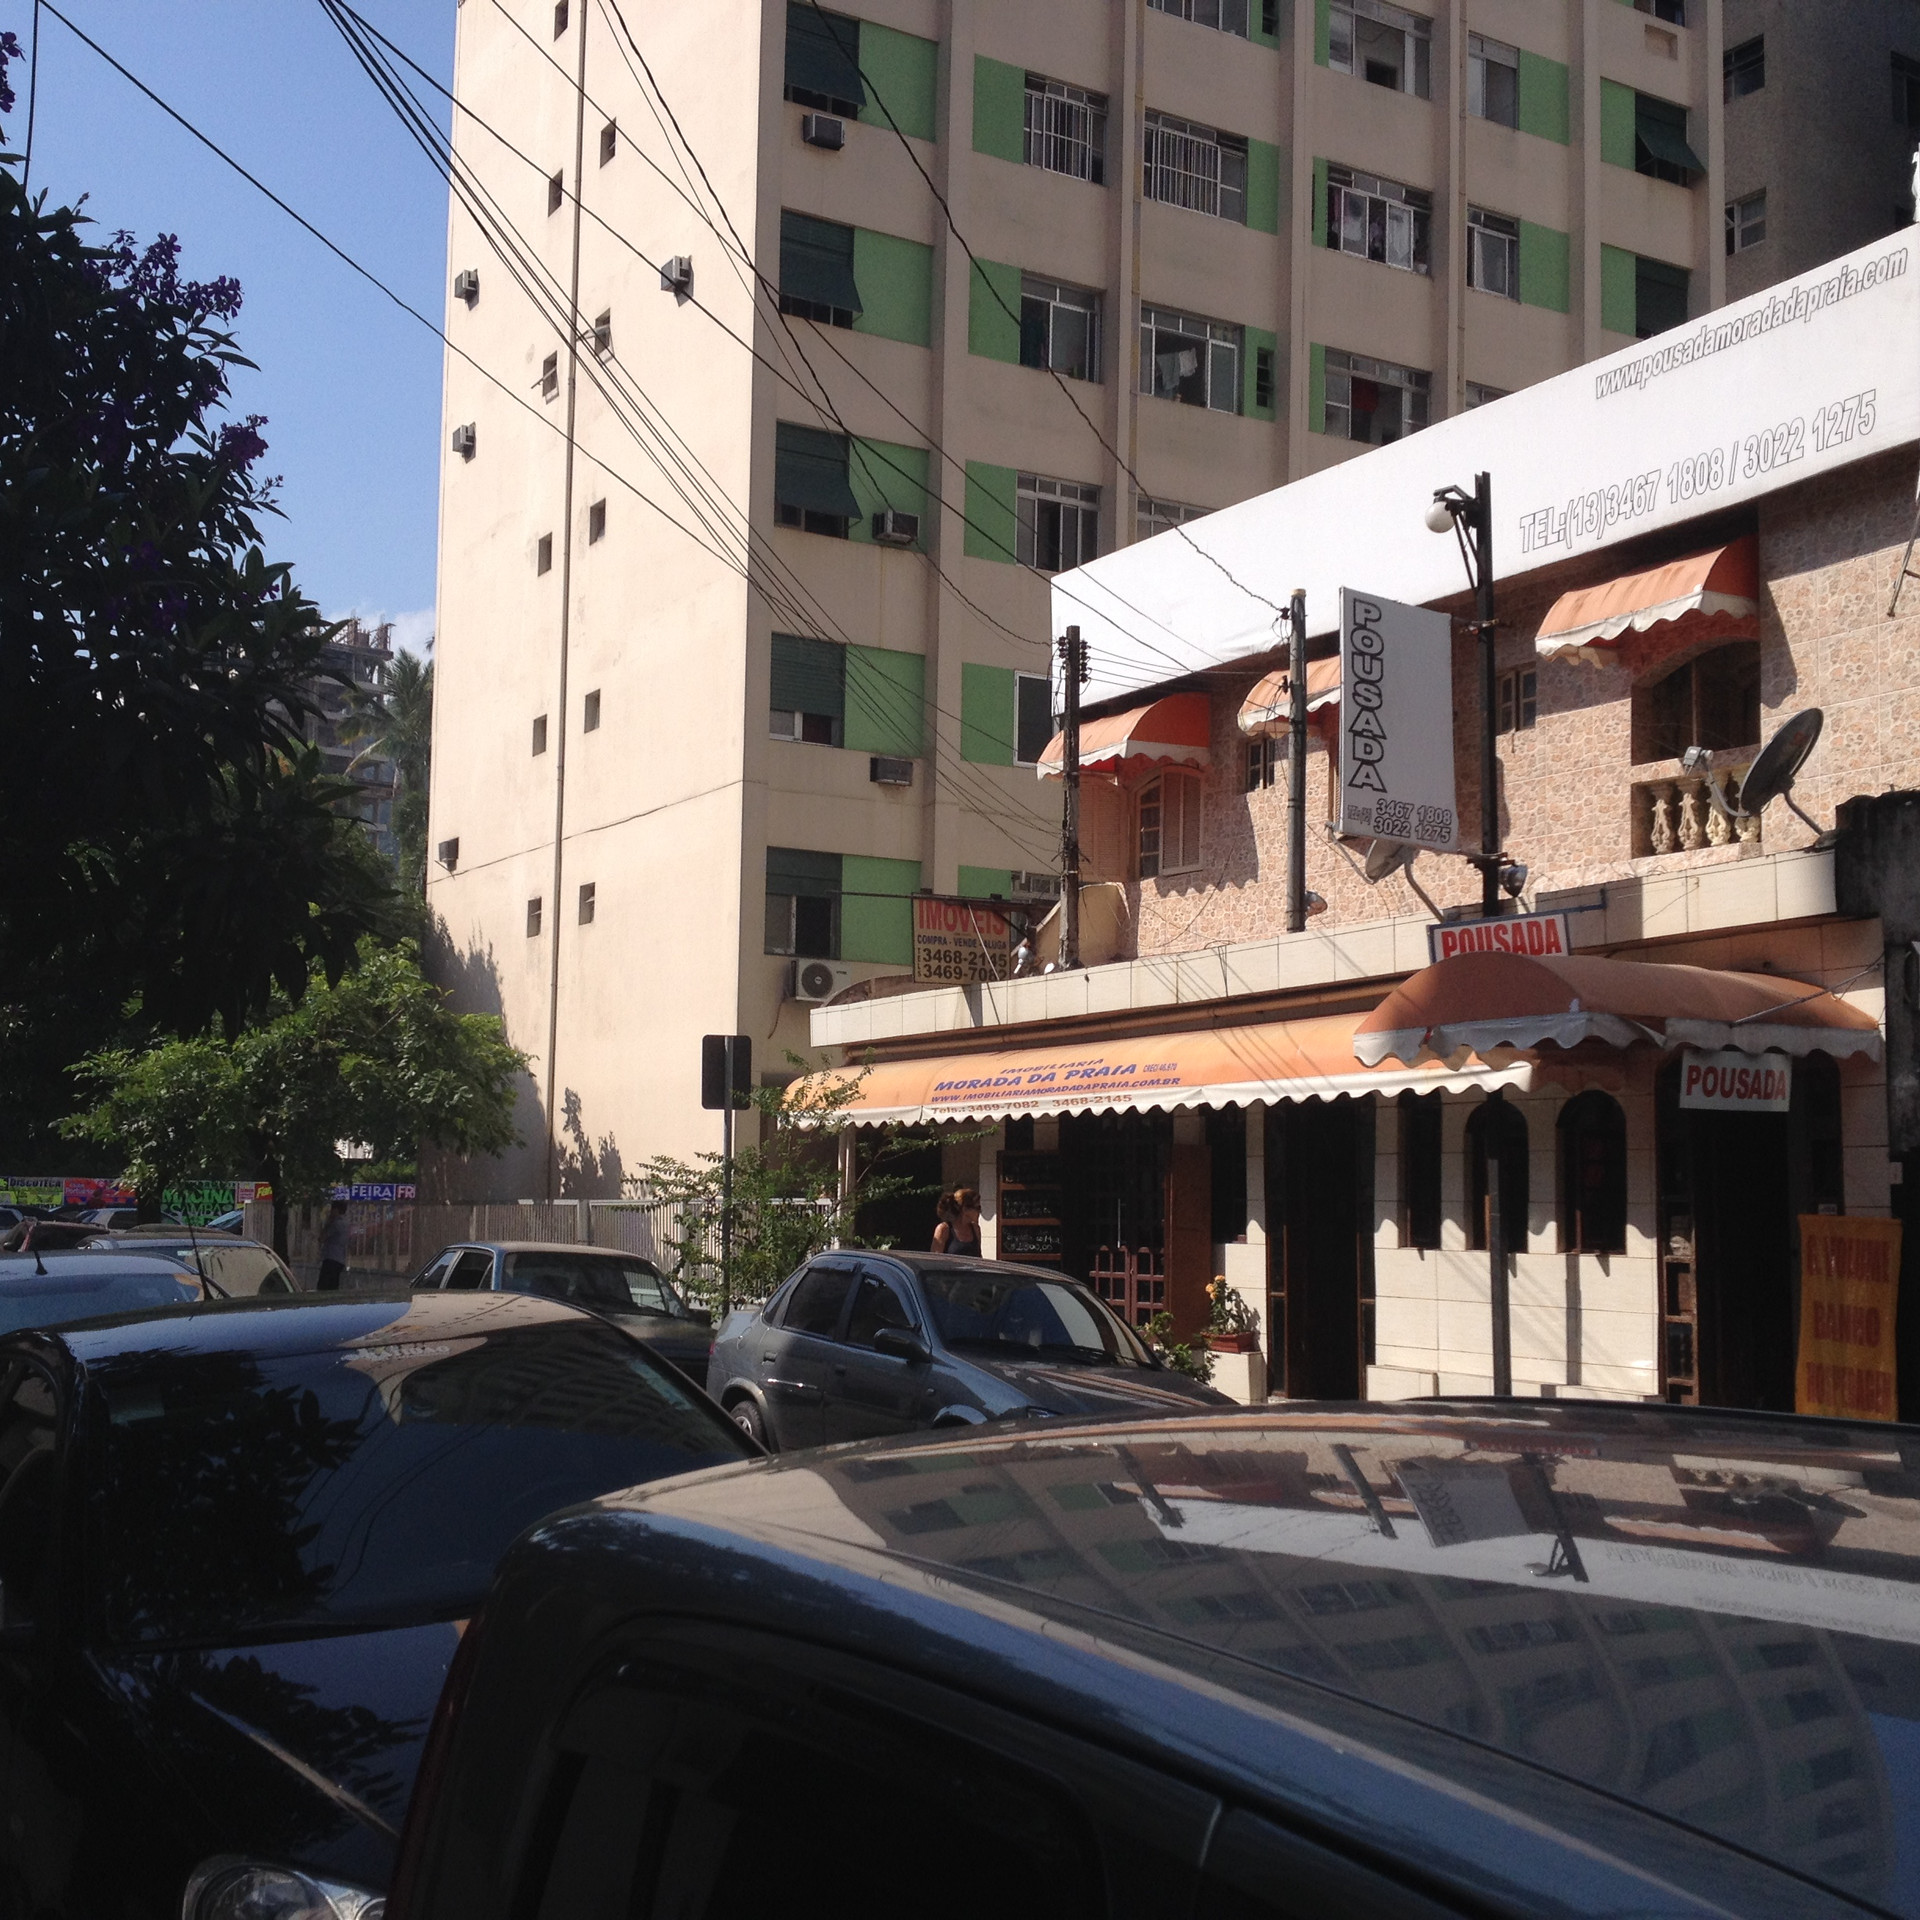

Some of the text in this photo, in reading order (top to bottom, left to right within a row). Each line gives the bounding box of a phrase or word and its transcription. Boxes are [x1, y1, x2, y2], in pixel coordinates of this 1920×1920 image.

[1596, 247, 1908, 399] www.pousadamoradadapraia.com
[1667, 448, 1725, 504] 1808
[1728, 442, 1739, 486] /
[1744, 417, 1805, 480] 3022
[1811, 389, 1877, 453] 1275
[1347, 598, 1388, 794] POUSADA
[1376, 798, 1414, 820] 3467
[1417, 804, 1452, 826] 1808
[1373, 815, 1411, 838] 3022
[1414, 822, 1451, 844] 1275
[917, 934, 949, 946] COMPRA
[954, 937, 977, 948] VENDE
[1441, 918, 1563, 958] POUSADA
[922, 947, 1007, 969] 3468-2145
[931, 1077, 1181, 1102] WWW.IMOBILIARIAMORADADAPRAIA.COM.BR
[934, 1063, 1137, 1092] MORADA DA PRAIA
[1686, 1064, 1786, 1100] POUSADA
[1052, 1094, 1133, 1107] 3468-2145
[9, 1178, 62, 1188] DISCOTECA
[351, 1185, 393, 1198] FEIRA
[169, 1203, 223, 1217] SAMBA
